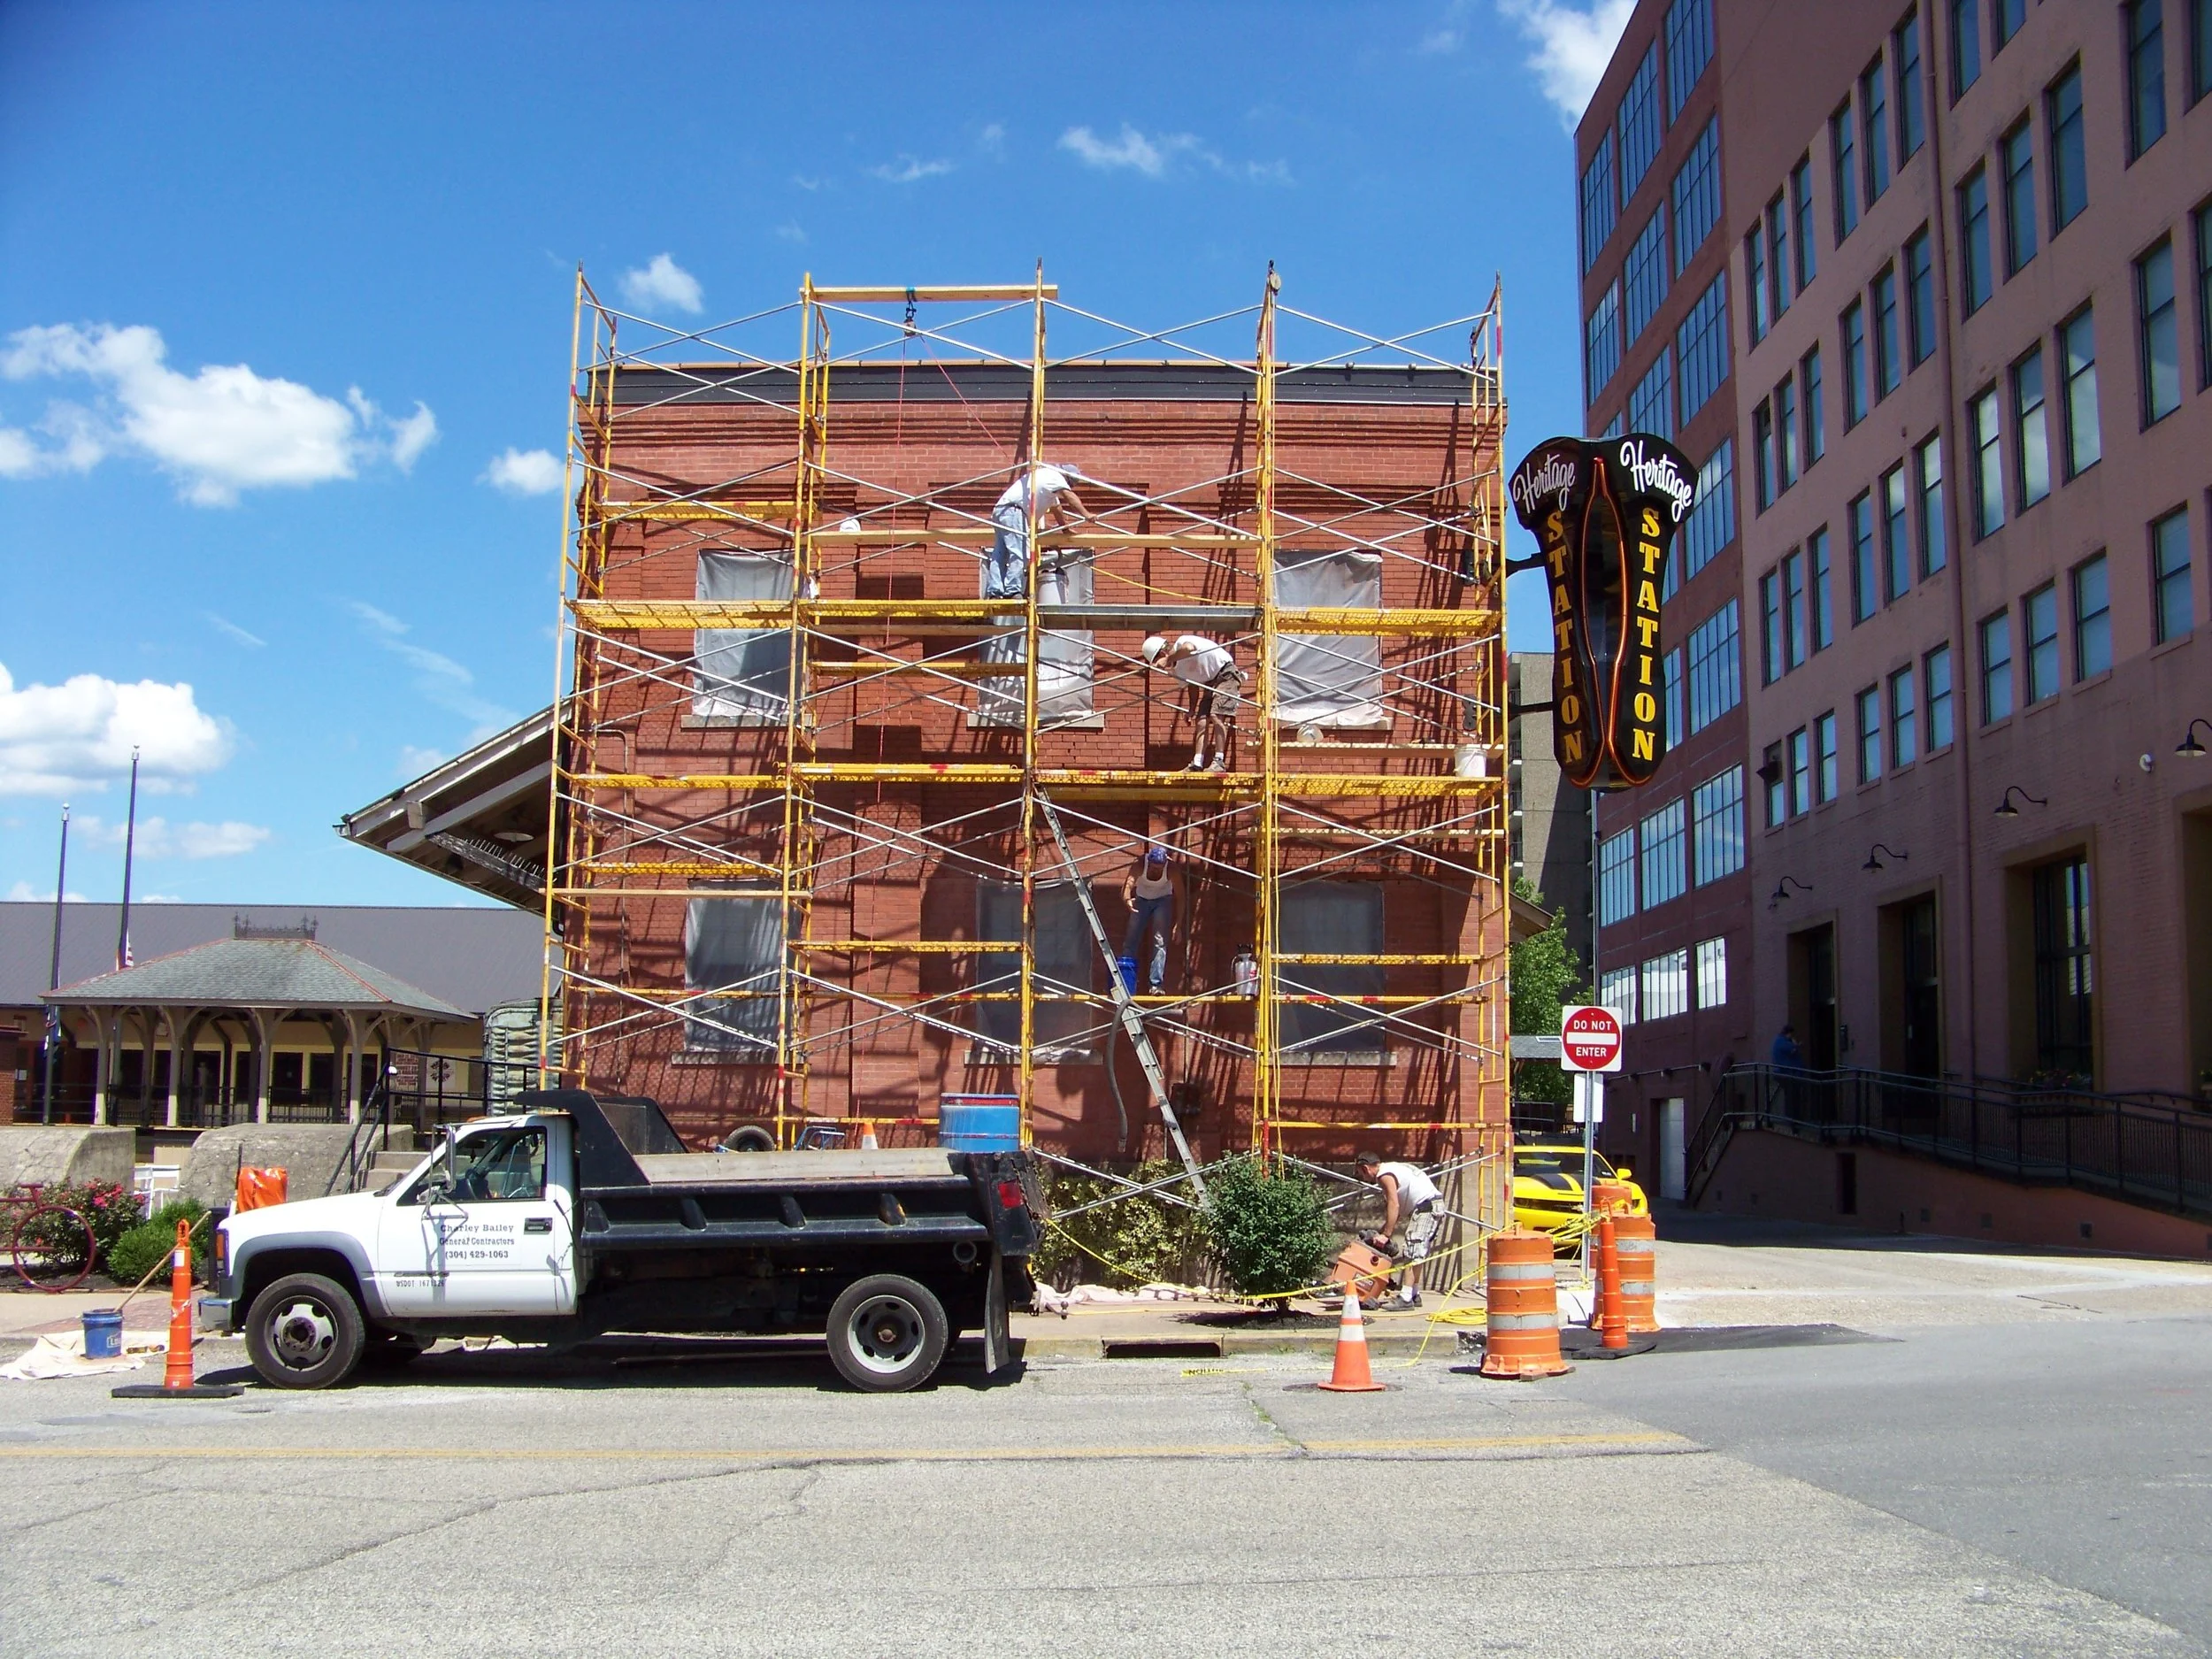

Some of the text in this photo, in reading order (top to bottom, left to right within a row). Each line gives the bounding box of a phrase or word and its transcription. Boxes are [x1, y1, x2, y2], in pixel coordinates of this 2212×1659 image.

[1513, 454, 1575, 513] Heritage
[1620, 440, 1692, 522] Heritage
[1547, 510, 1582, 764] STATION
[1632, 507, 1661, 762] STATION
[1573, 1019, 1612, 1031] DO NOT
[1576, 1047, 1607, 1057] ENTER
[440, 1225, 514, 1233] Charley Bailey
[439, 1237, 515, 1246] General Contractors
[445, 1250, 509, 1260] (304) 429-1063
